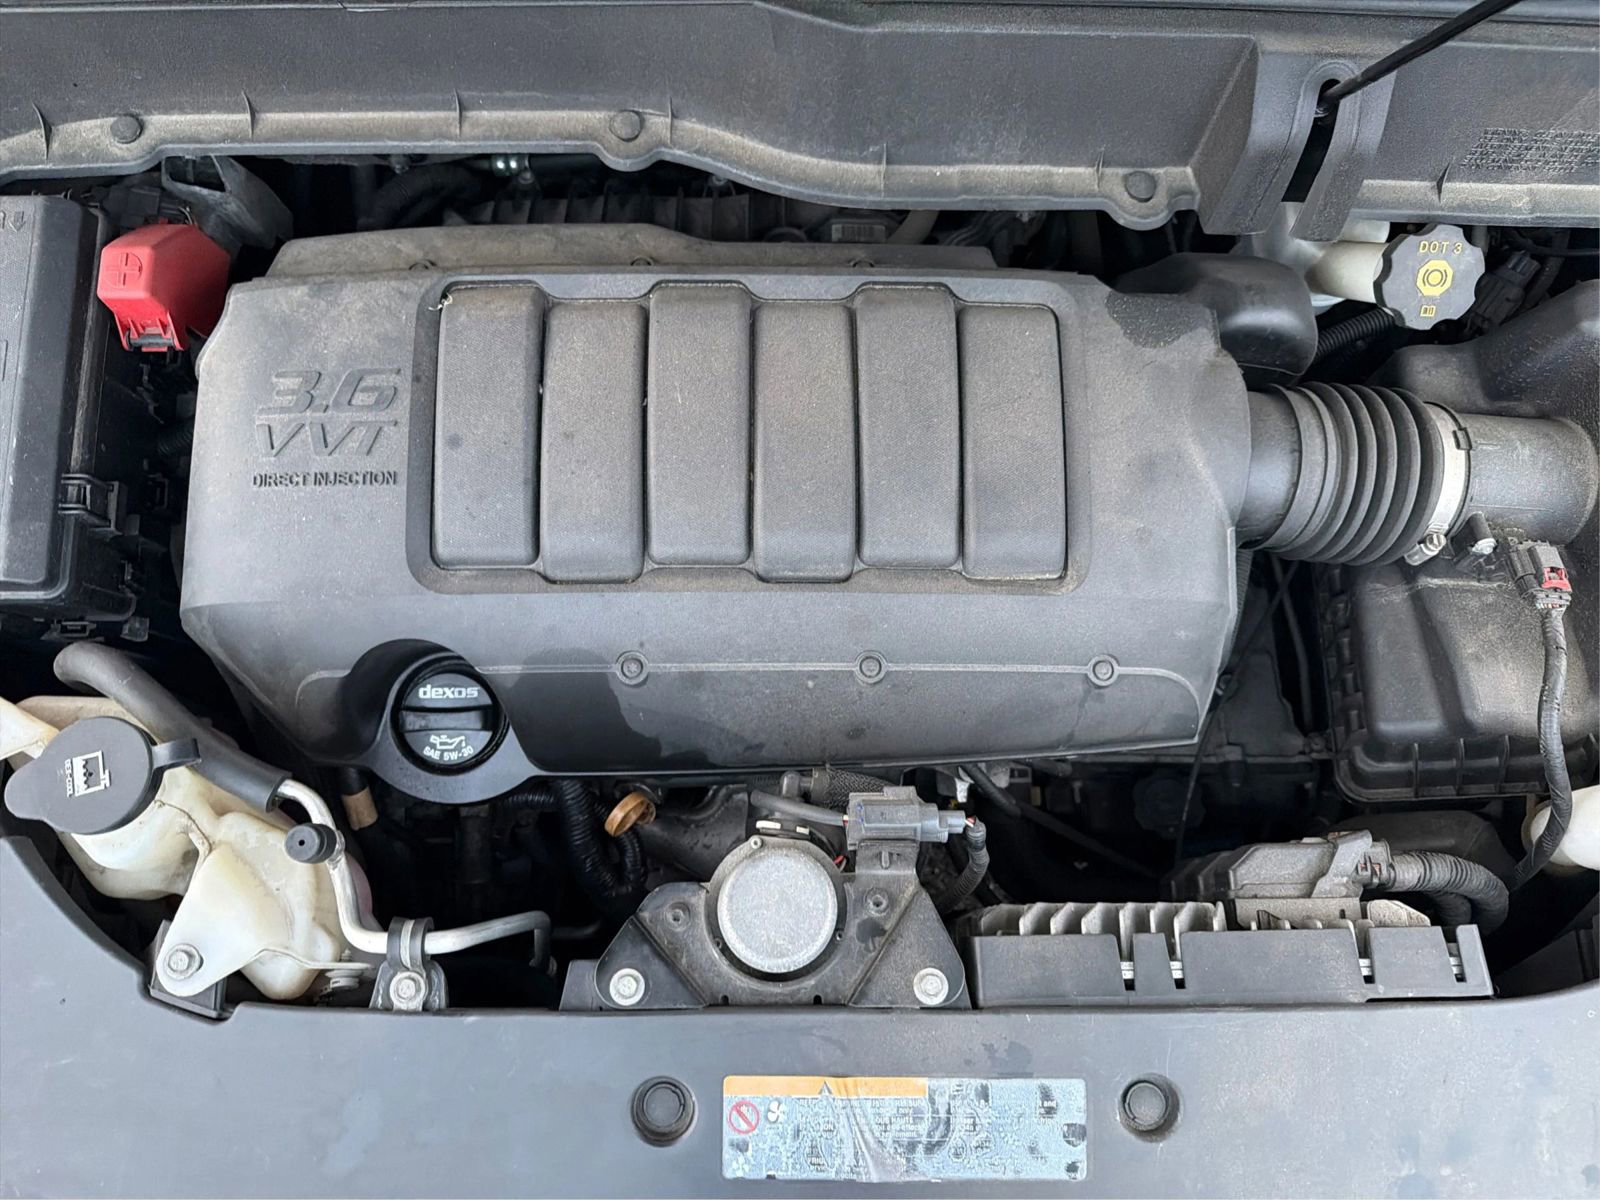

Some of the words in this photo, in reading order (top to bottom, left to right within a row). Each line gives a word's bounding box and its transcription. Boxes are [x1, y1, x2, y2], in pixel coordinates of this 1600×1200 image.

[1419, 241, 1449, 254] DOT
[1453, 242, 1463, 254] 3
[257, 368, 401, 413] 3.6
[255, 420, 398, 457] VVT
[253, 471, 310, 487] DIRECT
[313, 471, 397, 486] INJECTION
[418, 684, 479, 698] dexos
[423, 746, 441, 760] SAE
[443, 745, 474, 761] 5W-30
